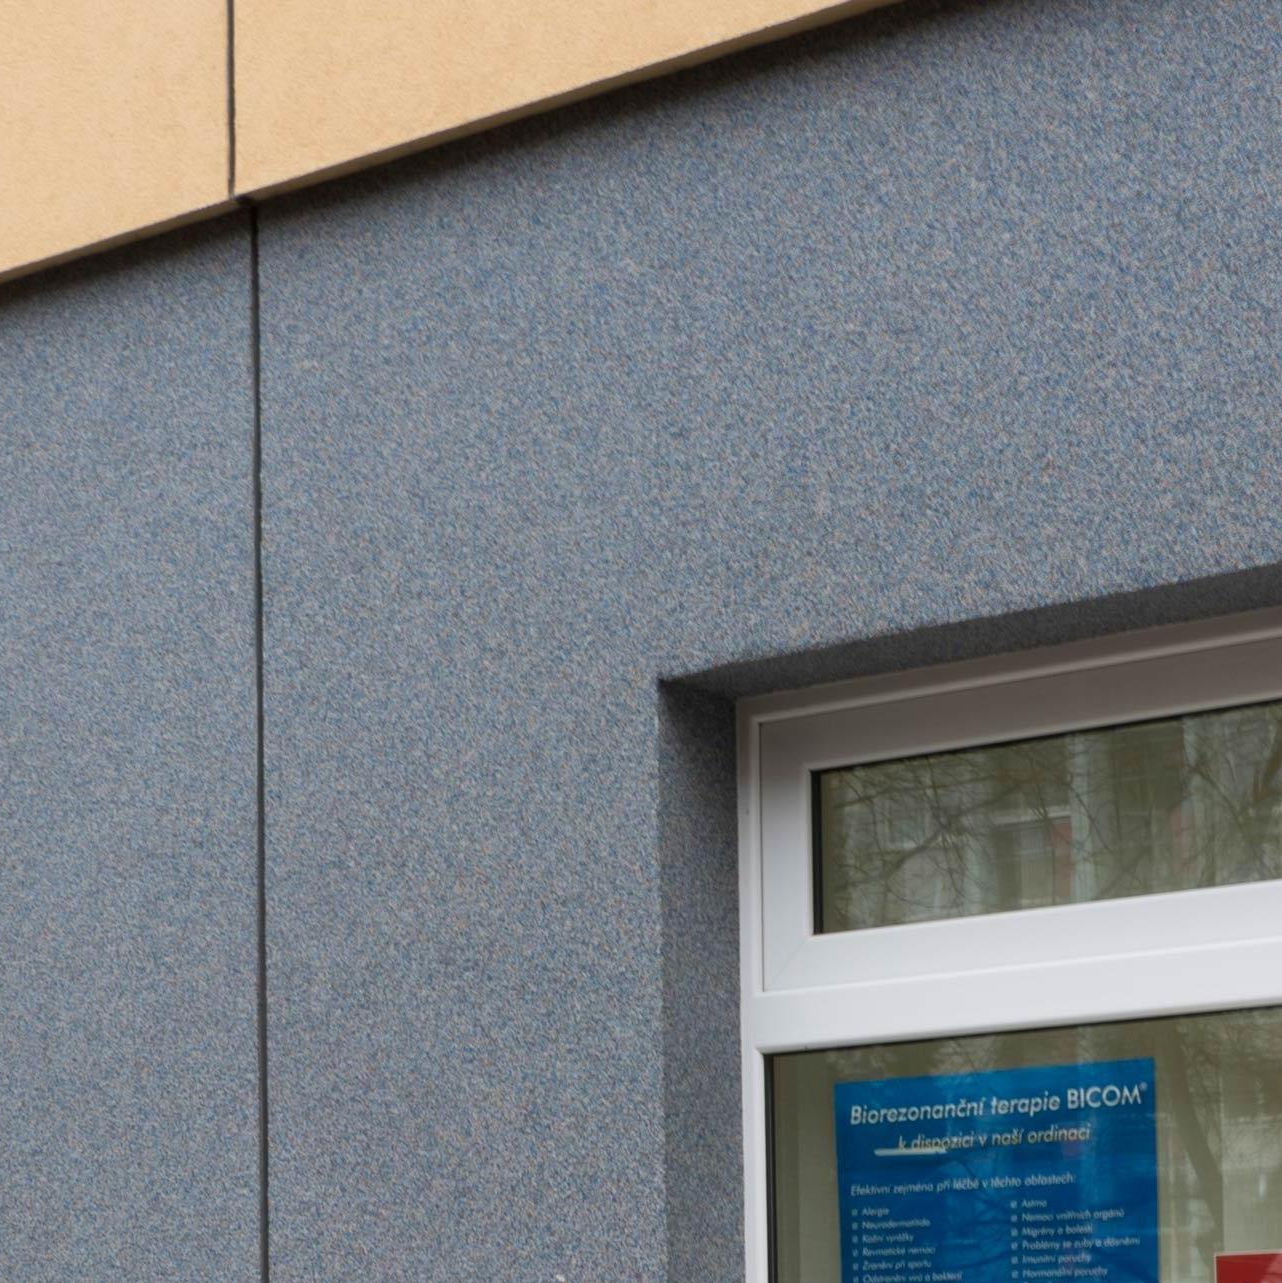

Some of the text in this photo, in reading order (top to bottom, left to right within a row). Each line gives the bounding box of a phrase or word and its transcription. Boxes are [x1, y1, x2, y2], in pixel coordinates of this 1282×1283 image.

[850, 1097, 985, 1125] Biorezonanční
[991, 1090, 1061, 1117] terapie
[911, 1131, 974, 1153] dispozici
[978, 1135, 988, 1147] v
[991, 1128, 1024, 1146] naší
[1027, 1123, 1091, 1144] ordinaci
[850, 1183, 891, 1196] Efektivní
